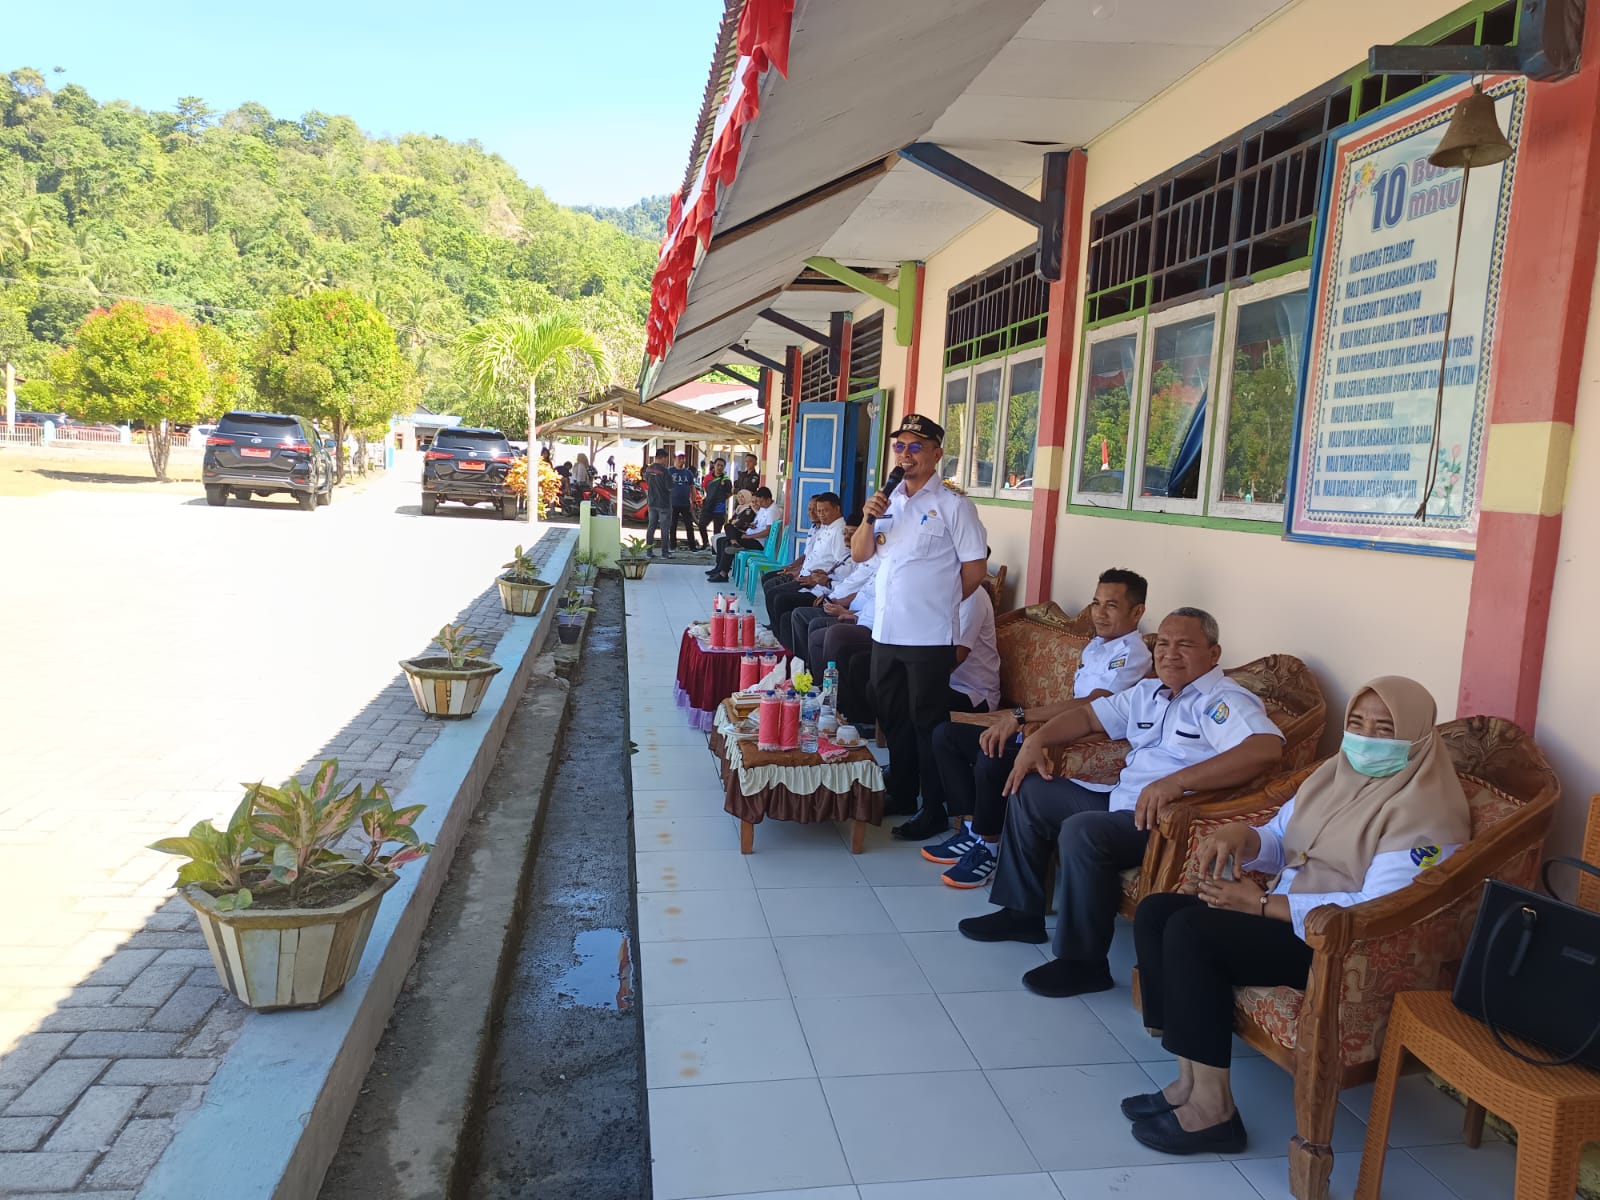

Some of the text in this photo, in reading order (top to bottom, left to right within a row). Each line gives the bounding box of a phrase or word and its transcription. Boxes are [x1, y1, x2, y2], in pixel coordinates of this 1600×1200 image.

[1371, 164, 1407, 231] 10
[1407, 177, 1462, 221] MALU
[1350, 254, 1363, 273] MALU
[1363, 248, 1383, 270] DATANG
[1383, 239, 1414, 264] TERLAMBAT
[1346, 279, 1360, 299] MALU
[1360, 275, 1376, 295] TIDAK
[1376, 264, 1417, 292] MELAKSANAKAN
[1418, 259, 1437, 282] TUGAS
[1343, 305, 1357, 324] MALU
[1357, 300, 1380, 321] BERBUAT
[1379, 296, 1396, 316] TIDAK
[1340, 330, 1353, 349] MALU
[1353, 327, 1372, 346] MASUK
[1372, 322, 1396, 343] SEKOLAH
[1395, 319, 1412, 339] TIDAK
[1412, 316, 1429, 336] TEPAT
[1429, 312, 1448, 333] WAKT
[1337, 356, 1351, 374] MALU
[1350, 352, 1377, 372] MENERIMA
[1377, 349, 1390, 368] GAJI
[1389, 347, 1406, 366] TIDAK
[1406, 339, 1452, 364] MELAKSANAKN
[1452, 336, 1474, 357] TUGAS
[1334, 381, 1348, 399] MALU
[1347, 379, 1366, 397] SERING
[1366, 375, 1393, 395] MENGIRIM
[1393, 373, 1411, 392] SURAT
[1411, 370, 1429, 390] SAKIT
[1462, 364, 1476, 385] IZIN
[1331, 406, 1345, 423] MALU
[1344, 404, 1364, 422] PULANG
[1364, 403, 1380, 421] LEBIH
[1379, 401, 1394, 420] AWAL
[1329, 431, 1342, 447] MALU
[1342, 430, 1357, 447] TIDAK
[1357, 427, 1399, 446] MELAKSANAKAN
[1398, 426, 1416, 444] KERJA
[1415, 425, 1433, 443] SAMA
[1326, 456, 1339, 472] MALU
[1339, 455, 1354, 472] TIDAK
[1354, 454, 1392, 471] BERTANGGUNG
[1392, 453, 1411, 471] JAWAB
[1323, 480, 1337, 496] MALU
[1337, 480, 1355, 496] DATANG
[1355, 480, 1367, 497] DAN
